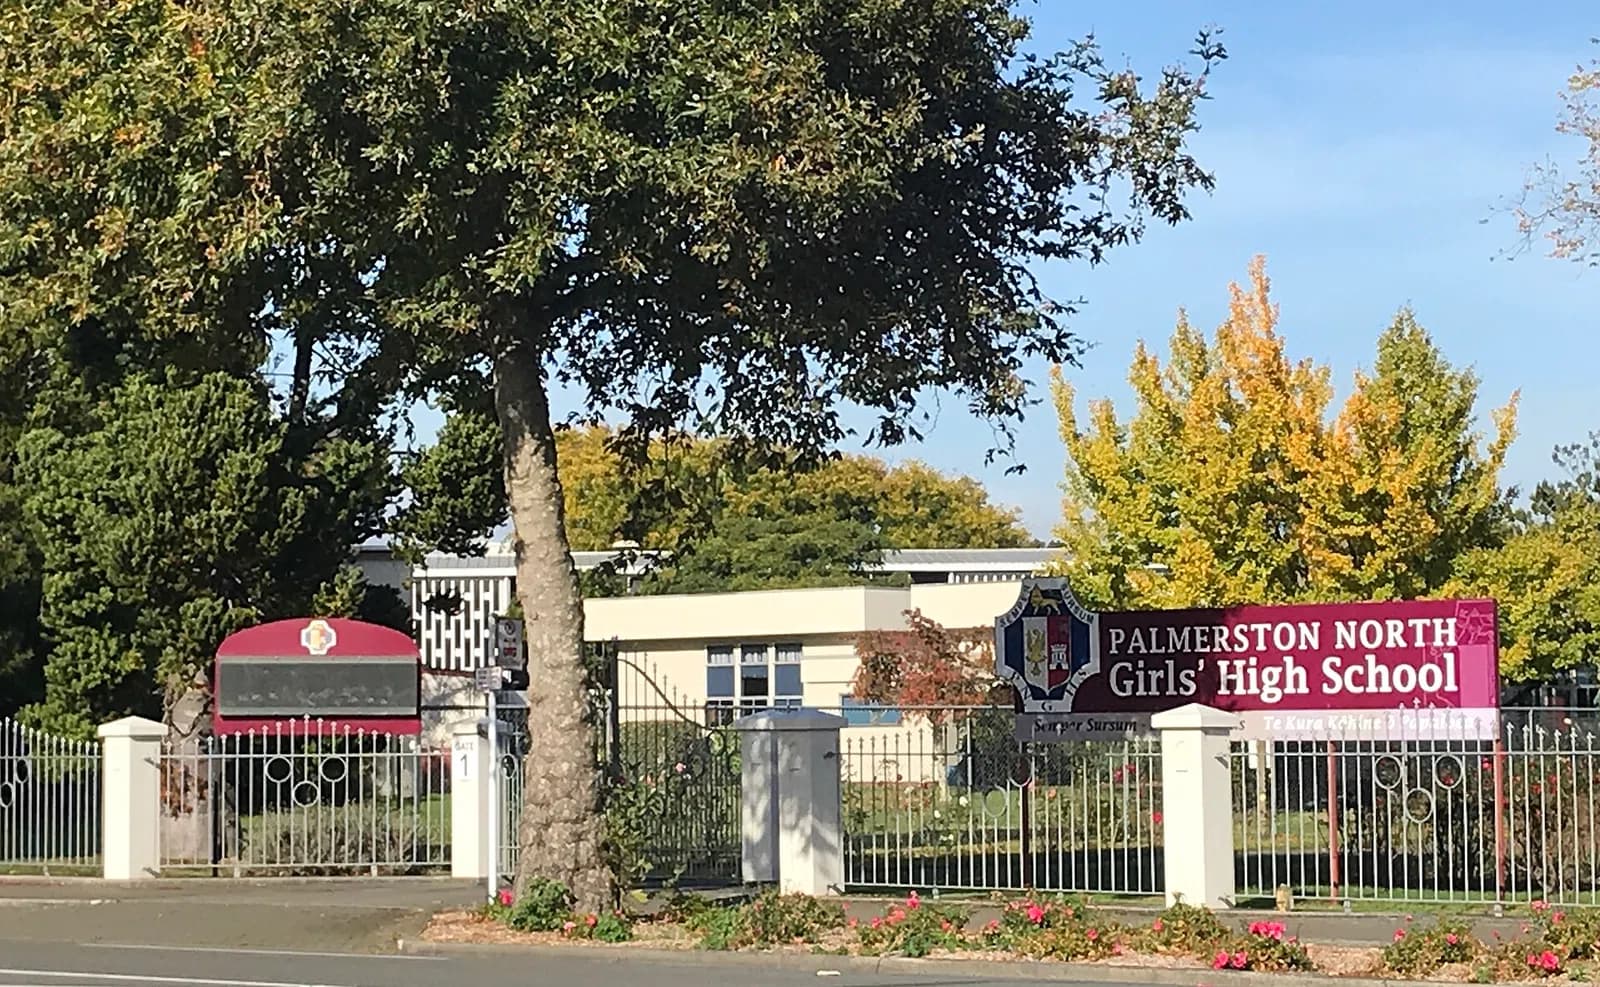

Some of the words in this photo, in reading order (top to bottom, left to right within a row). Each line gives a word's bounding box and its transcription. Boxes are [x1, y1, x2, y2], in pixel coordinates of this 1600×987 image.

[1109, 623, 1320, 655] PALMERSTON
[1335, 618, 1458, 650] NORTH
[1109, 658, 1205, 697] Girls'
[1217, 656, 1309, 704] High
[1322, 653, 1459, 694] School
[1086, 718, 1137, 731] Sursum
[1263, 715, 1282, 730] Te
[1285, 715, 1323, 730] Kura
[460, 753, 468, 777] 1
